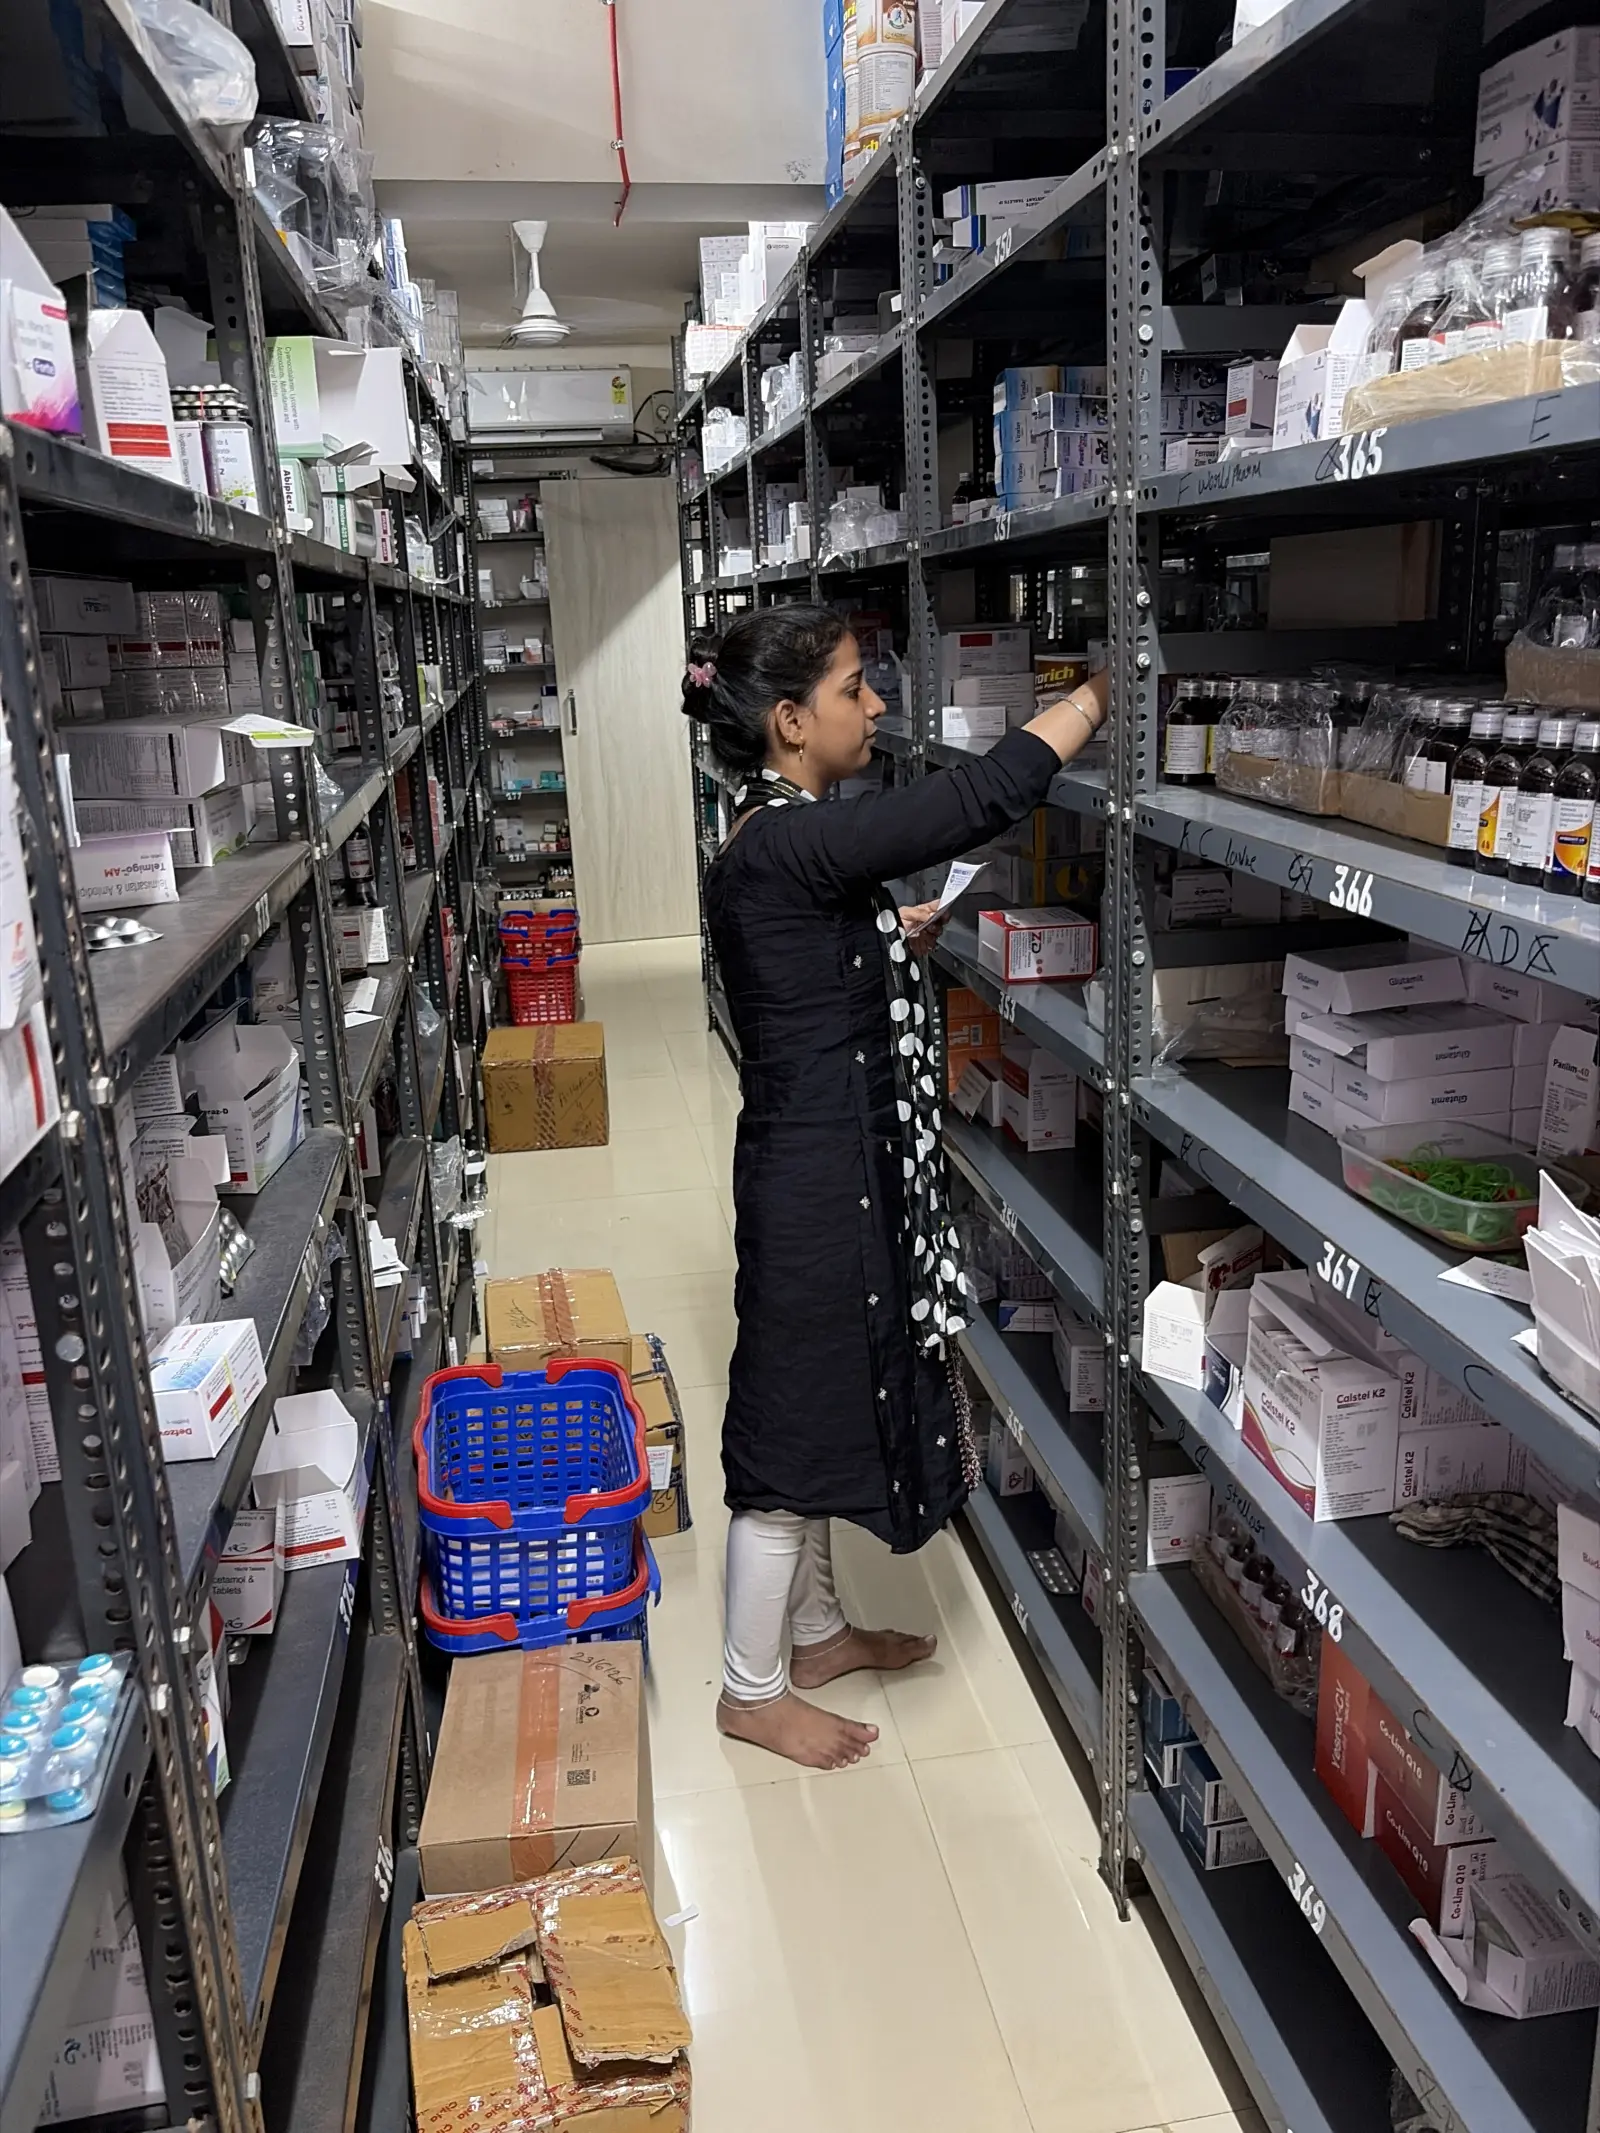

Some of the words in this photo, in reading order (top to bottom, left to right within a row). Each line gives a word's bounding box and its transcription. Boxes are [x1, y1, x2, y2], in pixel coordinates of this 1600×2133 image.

[1334, 427, 1388, 482] 365
[283, 469, 295, 513] Abiplex-F
[488, 665, 506, 673] 275
[498, 729, 514, 737] 276
[506, 792, 522, 801] 277
[116, 884, 123, 896] &
[125, 879, 168, 893] Telmisartan
[1329, 865, 1375, 917] 366
[1296, 972, 1319, 987] Glutamit
[1388, 974, 1424, 986] Glutamit
[1493, 982, 1519, 998] Glutamit
[1301, 1050, 1322, 1065] Glutamit
[1435, 1050, 1471, 1061] Glutamit
[1553, 1058, 1590, 1078] Panlim-40
[1302, 1091, 1322, 1108] Glutamit
[1431, 1095, 1468, 1105] Glutamit
[1000, 1200, 1018, 1236] 354
[1316, 1241, 1361, 1300] 367
[1404, 1371, 1415, 1386] K2
[1336, 1392, 1371, 1404] Calstel
[1372, 1388, 1386, 1399] K2
[1401, 1386, 1413, 1419] Calstel
[1261, 1392, 1286, 1427] Calstel
[1285, 1416, 1296, 1436] K2
[1405, 1451, 1415, 1466] K2
[1402, 1467, 1413, 1498] Calstel
[212, 1586, 242, 1595] Tablets
[1301, 1568, 1344, 1643] 368
[1379, 1719, 1406, 1759] Co-Lim
[1405, 1753, 1423, 1780] Q10
[1445, 1790, 1457, 1826] Co-Lim
[1386, 1809, 1413, 1854] Co-Lim
[1411, 1846, 1429, 1873] Q10
[1455, 1864, 1466, 1885] Q10
[600, 1881, 623, 1896] Cipla
[1287, 1861, 1327, 1935] 369
[1451, 1887, 1464, 1919] Co-Lim
[512, 1985, 531, 2005] Cipla
[564, 2021, 585, 2039] Cipla
[430, 2101, 458, 2123] Cipla
[485, 2098, 512, 2119] Cipla
[512, 2095, 539, 2117] Cipla
